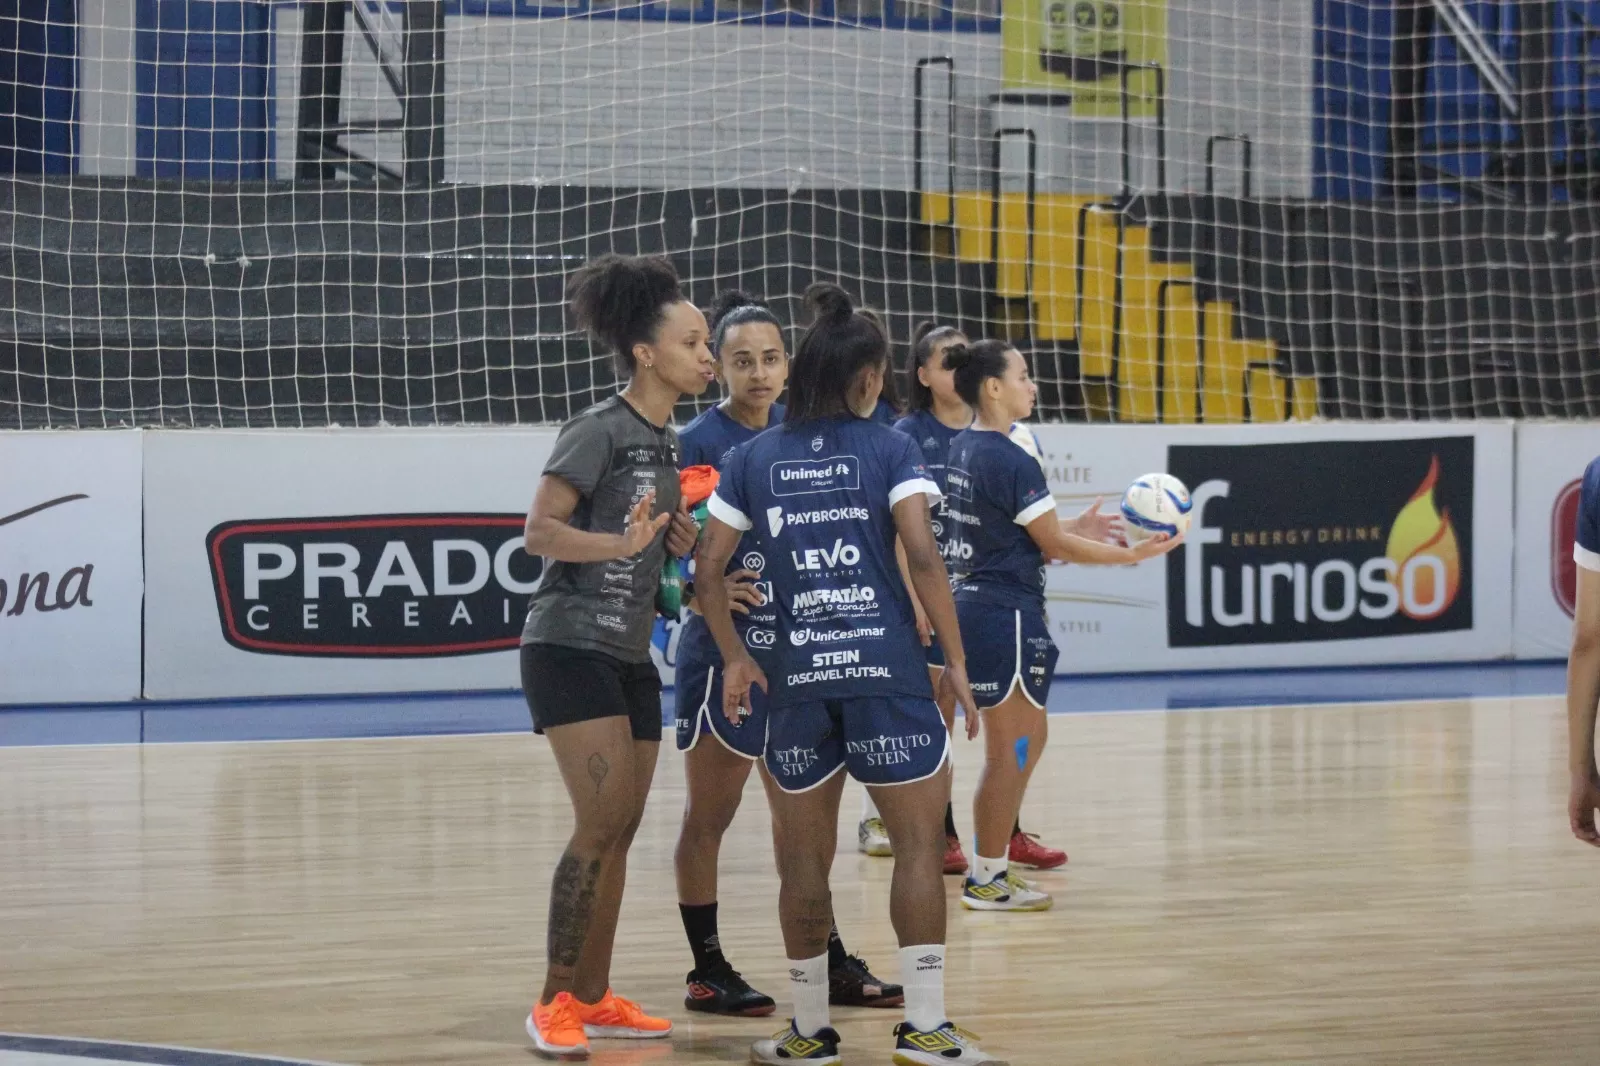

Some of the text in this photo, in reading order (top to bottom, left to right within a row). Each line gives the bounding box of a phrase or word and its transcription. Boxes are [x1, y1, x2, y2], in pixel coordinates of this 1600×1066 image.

[780, 465, 832, 481] Unimed
[786, 507, 869, 525] PAYBROKERS
[1230, 525, 1381, 547] ENERGY DRINK
[791, 538, 861, 571] LEVO
[1184, 479, 1446, 628] furioso
[243, 536, 545, 600] PRADO
[800, 568, 862, 580] ALIMENTOS
[793, 583, 875, 609] MUFFATÃO
[246, 597, 511, 632] CEREAI
[802, 606, 824, 618] super
[836, 601, 879, 613] coração
[811, 627, 886, 642] UniCesumar
[812, 650, 860, 667] STEIN
[787, 667, 892, 686] CASCAVEL FUTSAL
[847, 734, 931, 754] INSTITUTO
[867, 750, 911, 766] STEIN
